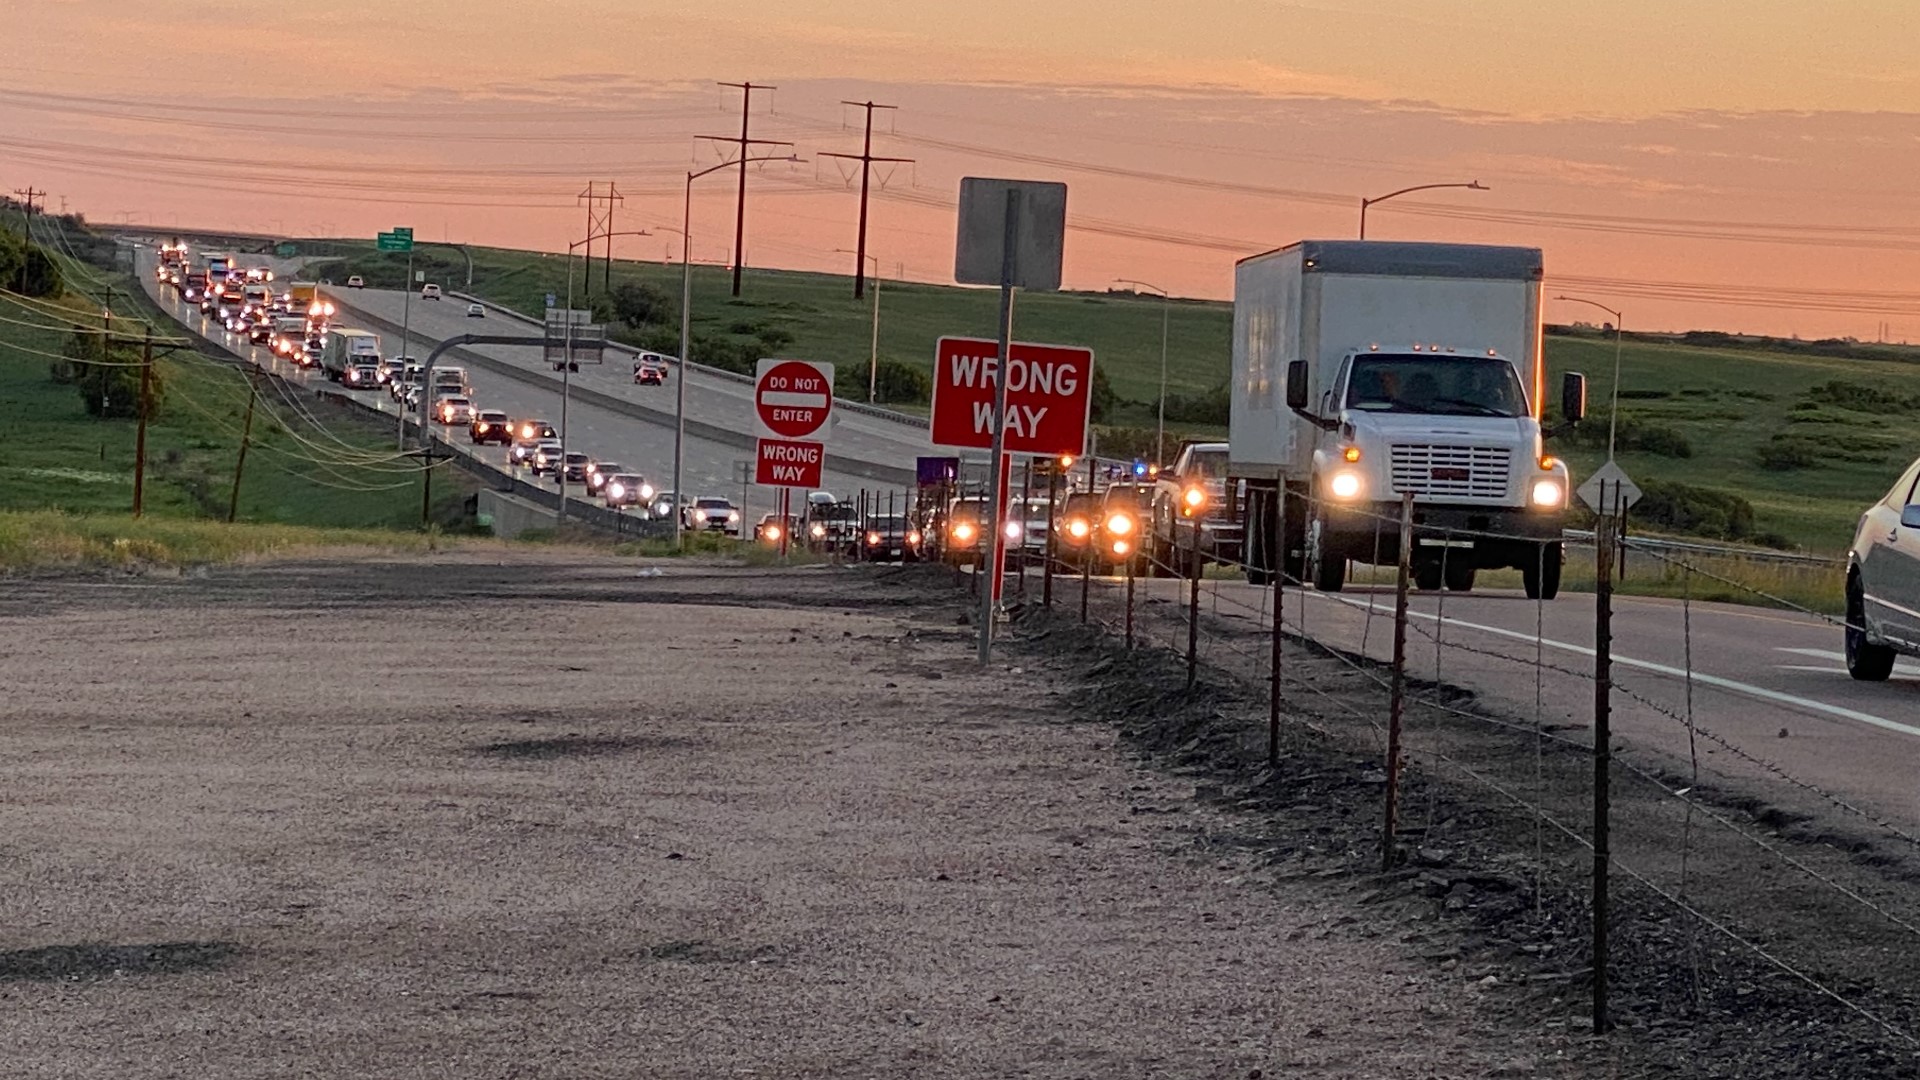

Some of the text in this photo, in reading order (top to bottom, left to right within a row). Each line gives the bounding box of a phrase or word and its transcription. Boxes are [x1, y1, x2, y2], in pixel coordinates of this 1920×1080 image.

[770, 377, 820, 390] DO NOT
[952, 355, 1078, 397] WRONG
[773, 409, 813, 422] ENTER
[973, 402, 1048, 439] WAY
[763, 445, 818, 464] WRONG
[773, 465, 806, 482] WAY
